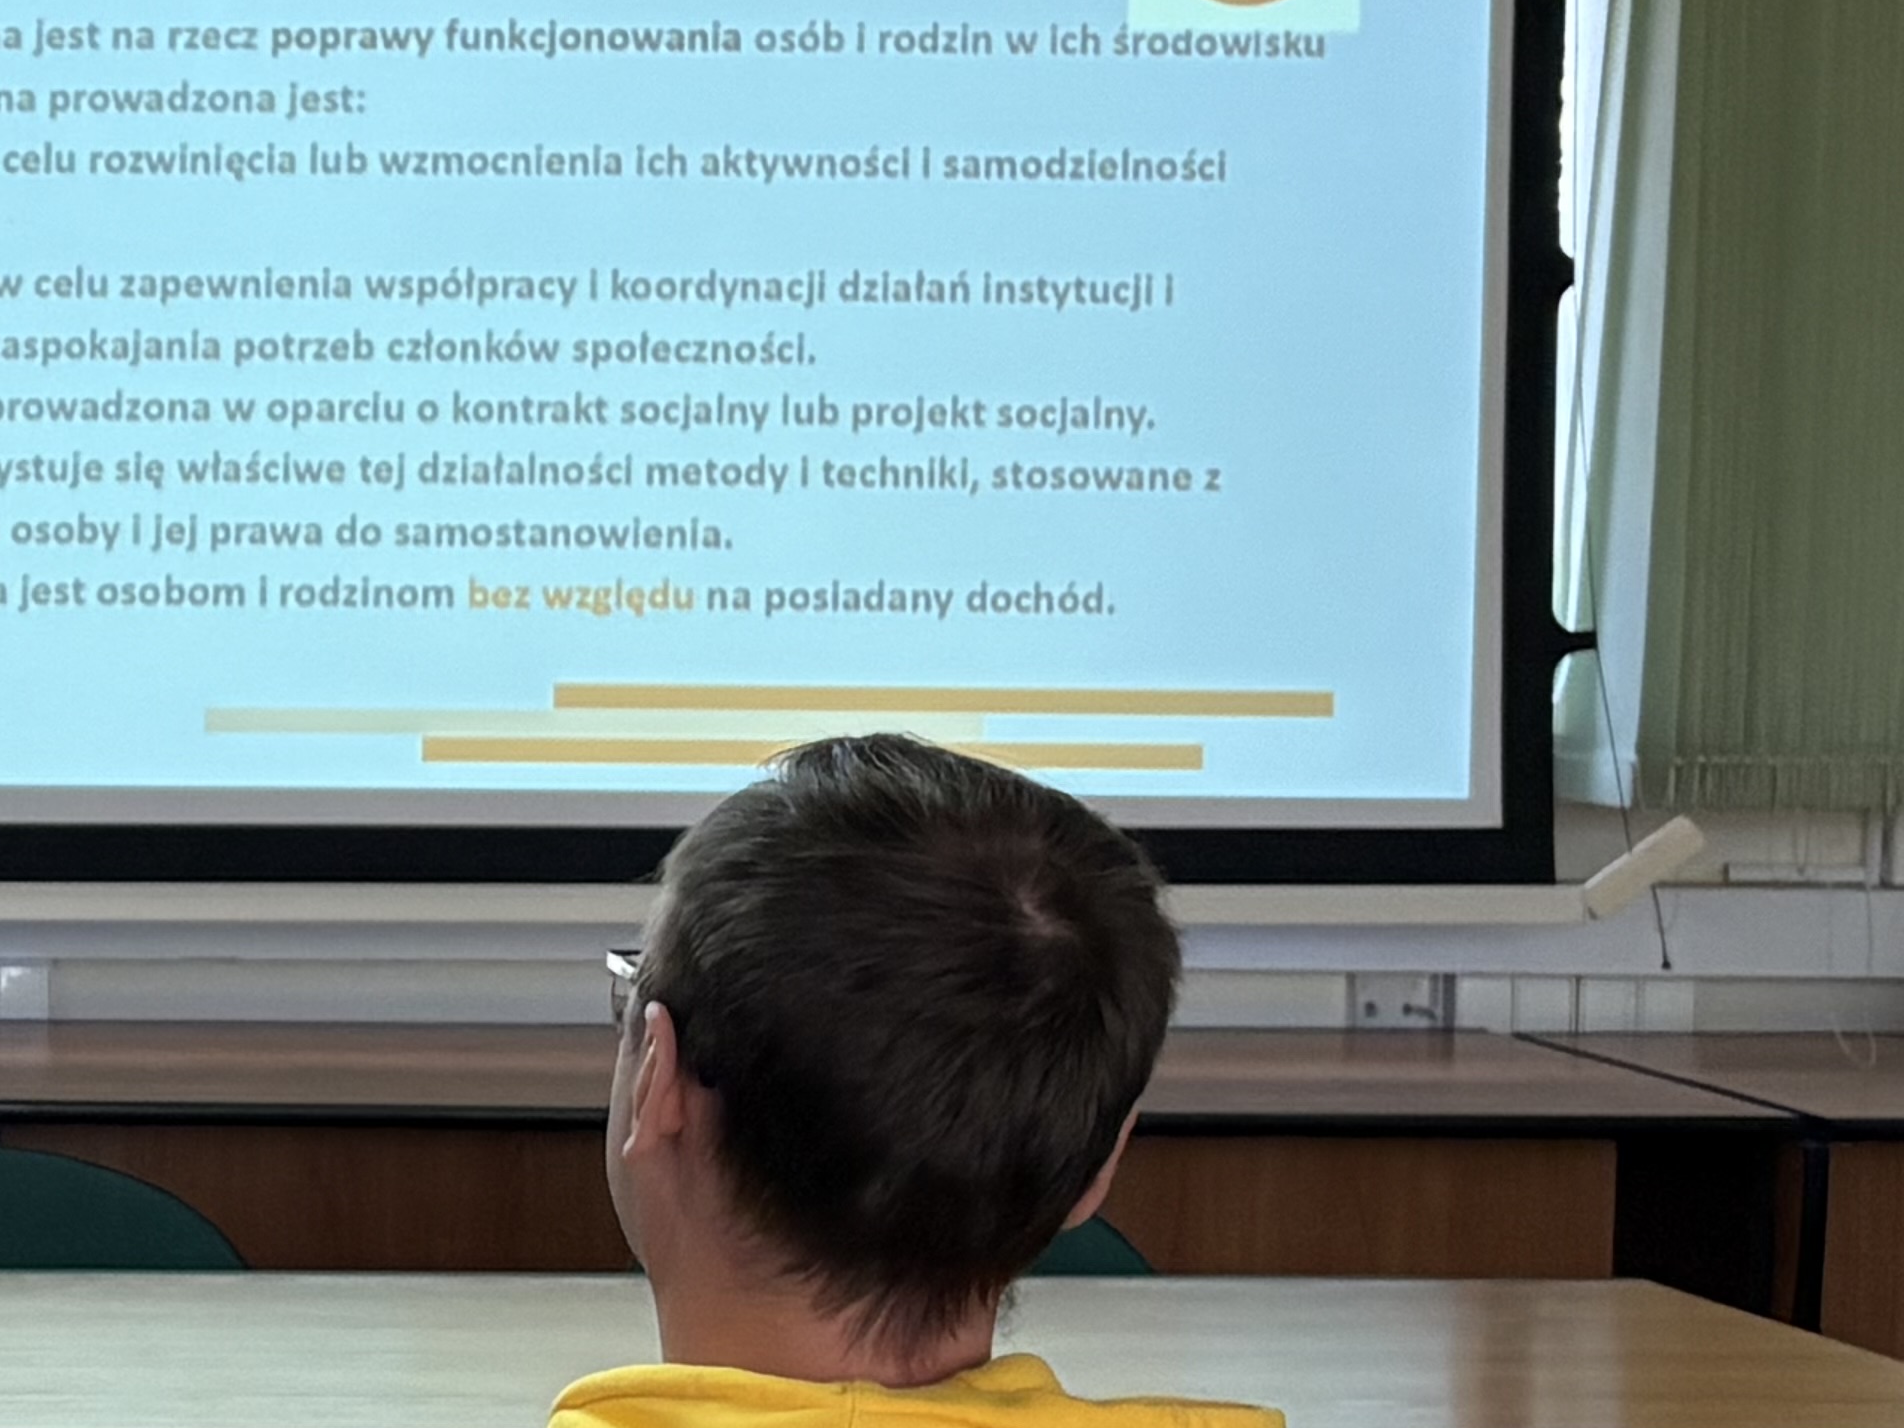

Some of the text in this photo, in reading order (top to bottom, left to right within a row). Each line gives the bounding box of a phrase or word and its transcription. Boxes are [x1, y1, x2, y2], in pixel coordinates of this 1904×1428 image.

[32, 18, 101, 58] jest
[111, 26, 155, 51] na
[167, 26, 259, 51] rzecz
[270, 26, 435, 59] poprawy
[444, 17, 742, 59] funkcjonowania
[754, 19, 845, 53] osób
[856, 21, 866, 54] i
[878, 21, 993, 55] rodzin
[1005, 31, 1038, 55] w
[1050, 22, 1101, 56] ich
[1112, 23, 1326, 60] środowisku
[48, 79, 277, 121] prowadzona
[285, 81, 366, 121] jest:
[2, 141, 76, 175] celu
[89, 142, 297, 183] rozwinięcia
[309, 141, 369, 176] lub
[378, 144, 623, 177] wzmocnienia
[635, 143, 688, 177] ich
[700, 144, 910, 185] aktywności
[922, 145, 931, 179] i
[943, 147, 1227, 182] samodzielności
[34, 265, 109, 299] celu
[119, 266, 353, 307] zapewnienia
[364, 266, 578, 308] współpracy
[589, 267, 598, 301] i
[610, 267, 826, 310] koordynacji
[838, 269, 971, 304] działań
[983, 271, 1153, 311] instytucji
[1164, 273, 1174, 306] i
[233, 328, 375, 368] potrzeb
[386, 328, 561, 364] członków
[572, 330, 816, 371] społeczności.
[222, 398, 256, 423] w
[266, 390, 405, 430] oparciu
[416, 399, 440, 424] o
[452, 390, 609, 426] kontrakt
[620, 392, 770, 433] socjalny
[781, 392, 840, 427] lub
[851, 394, 987, 435] projekt
[997, 395, 1156, 435] socjalny.
[114, 450, 165, 491] się
[177, 449, 346, 485] właściwe
[358, 452, 406, 492] tej
[417, 450, 633, 487] działalności
[645, 453, 789, 495] metody
[800, 455, 810, 488] i
[821, 455, 979, 496] techniki,
[991, 461, 1193, 492] stosowane
[1204, 468, 1221, 492] z
[10, 511, 121, 553] osoby
[132, 512, 141, 546] i
[150, 513, 198, 553] jej
[210, 521, 324, 553] prawa
[334, 513, 383, 547] do
[394, 516, 733, 550] samostanowienia.
[17, 573, 86, 614] jest
[96, 573, 246, 608] osobom
[258, 574, 268, 608] i
[279, 574, 455, 609] rodzinom
[467, 576, 531, 611] bez
[541, 577, 695, 619] względu
[706, 586, 752, 612] na
[764, 579, 954, 621] posiadany
[965, 580, 1116, 616] dochód.
